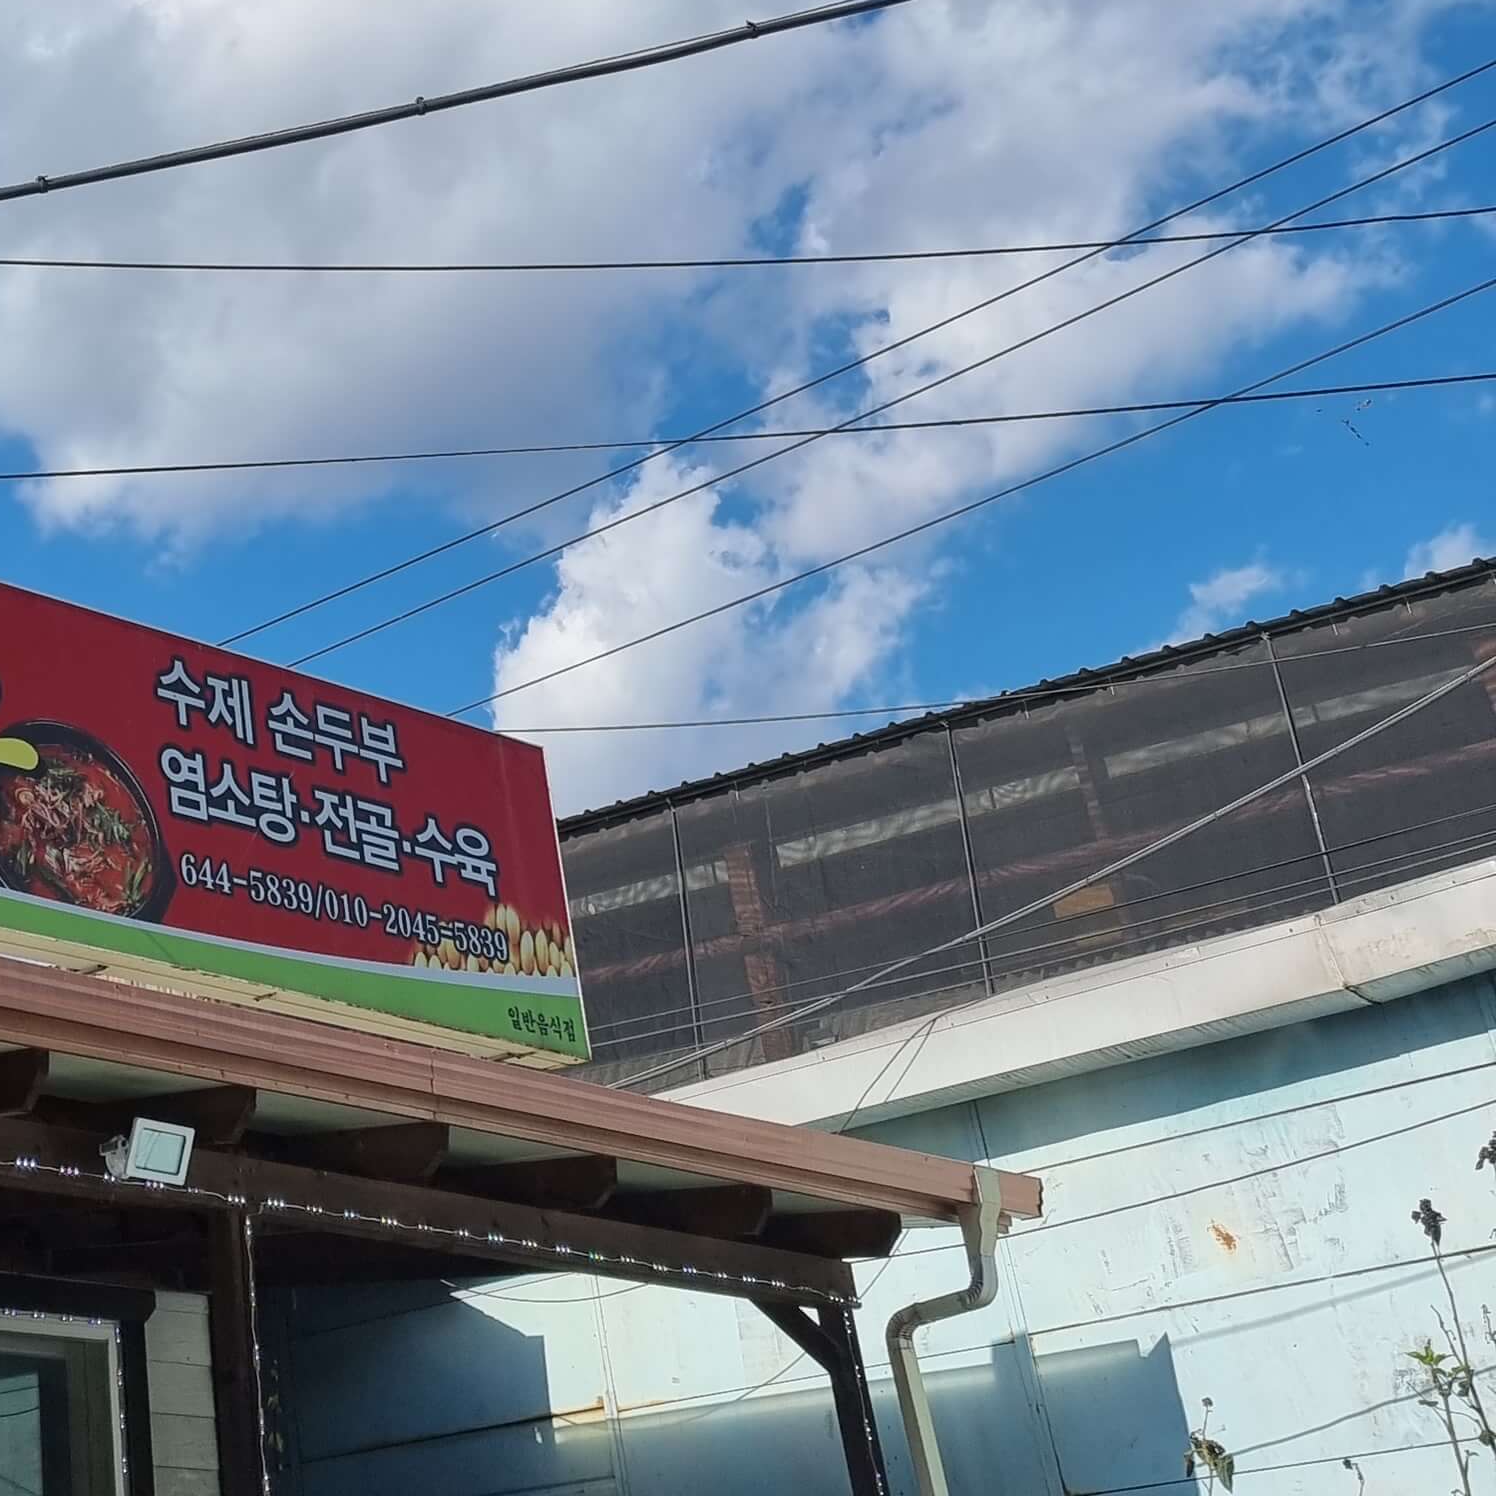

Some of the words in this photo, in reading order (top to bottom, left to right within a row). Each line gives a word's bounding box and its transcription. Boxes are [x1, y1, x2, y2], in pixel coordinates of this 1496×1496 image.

[157, 659, 255, 745] 수제
[267, 692, 404, 784] 손두부
[507, 1006, 576, 1042] 일반음식점
